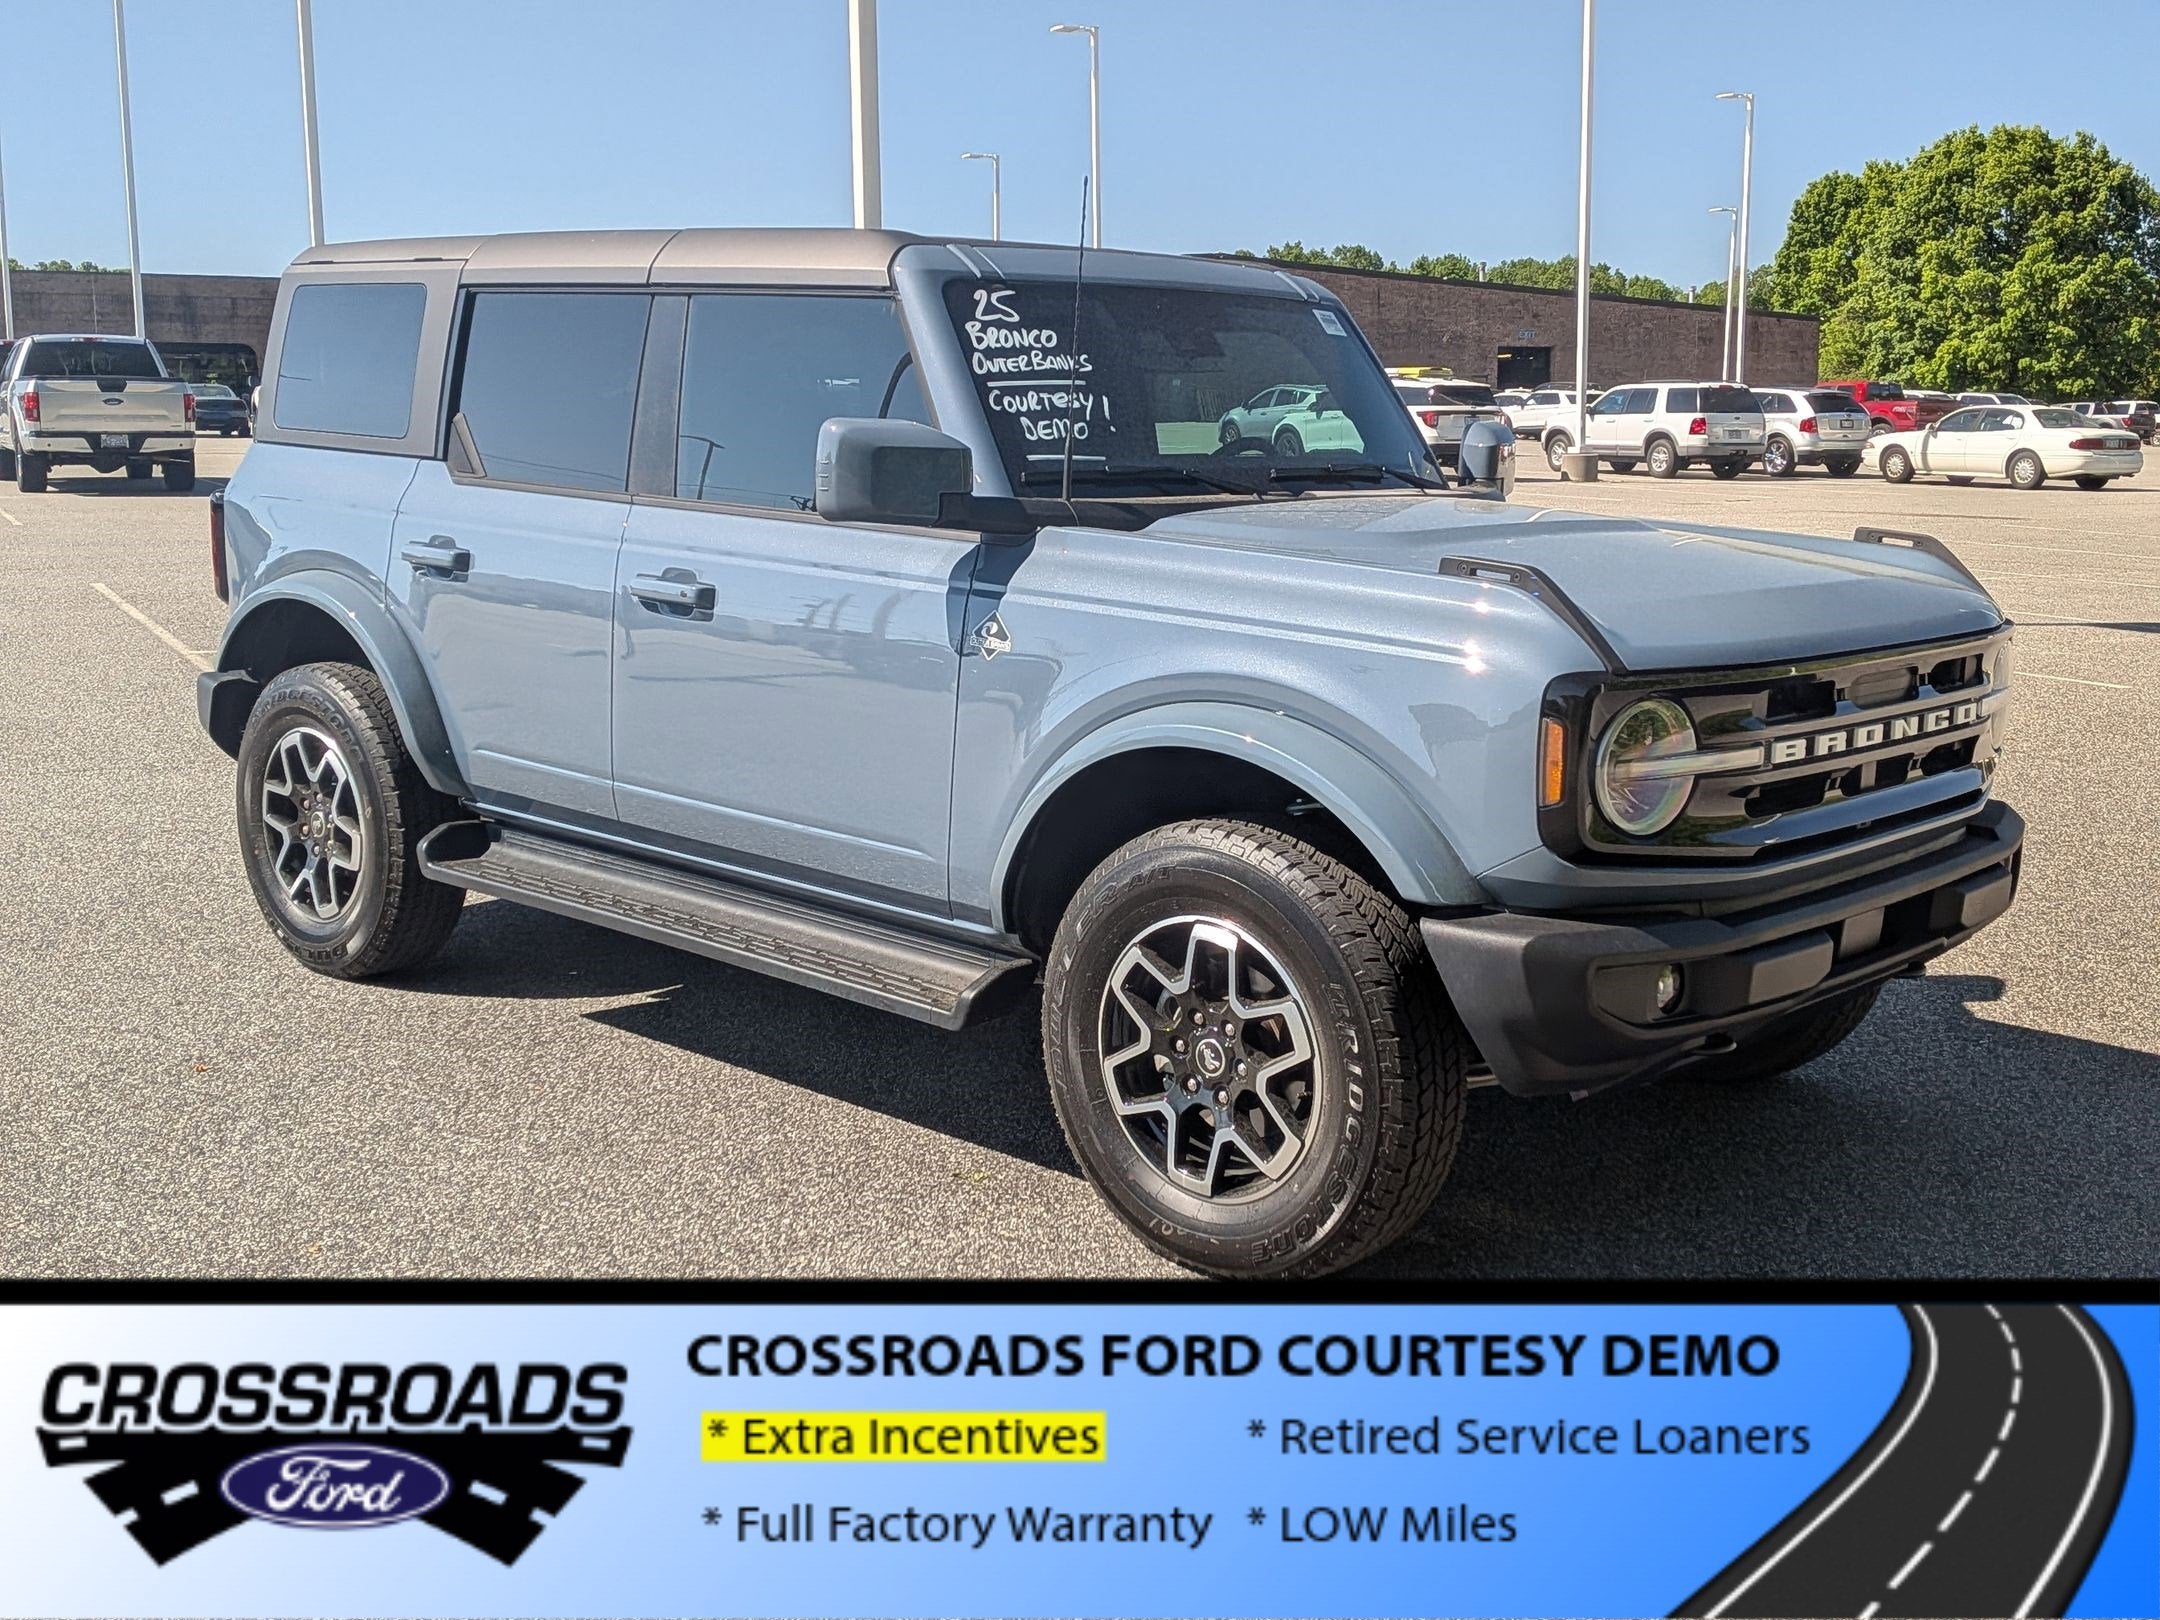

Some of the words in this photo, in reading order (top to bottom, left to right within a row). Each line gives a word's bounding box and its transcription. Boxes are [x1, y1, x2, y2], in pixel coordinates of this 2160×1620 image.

[973, 289, 1020, 322] 25
[965, 321, 1057, 350] BRONCO
[1020, 416, 1088, 440] DEMO
[1771, 702, 1977, 764] BRONCO
[1250, 982, 1364, 1266] BRIDGESTONE
